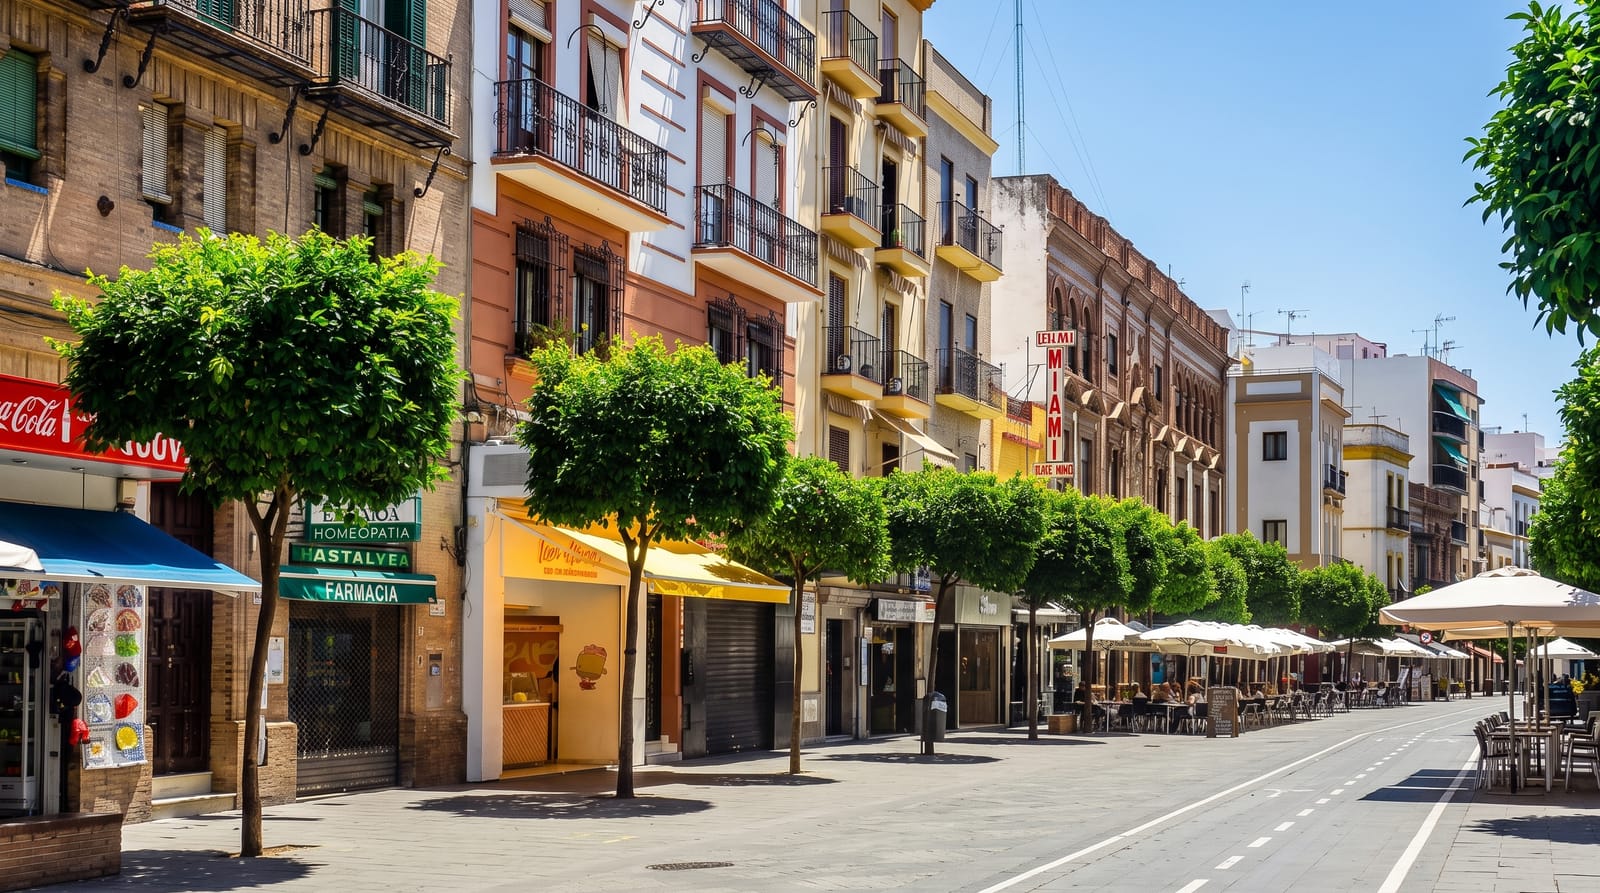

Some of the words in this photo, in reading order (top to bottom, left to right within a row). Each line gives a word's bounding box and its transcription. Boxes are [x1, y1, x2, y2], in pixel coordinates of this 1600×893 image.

[1048, 349, 1062, 461] MIAMI
[314, 527, 410, 540] HOMEOPATIA
[325, 582, 399, 602] FARMACIA
